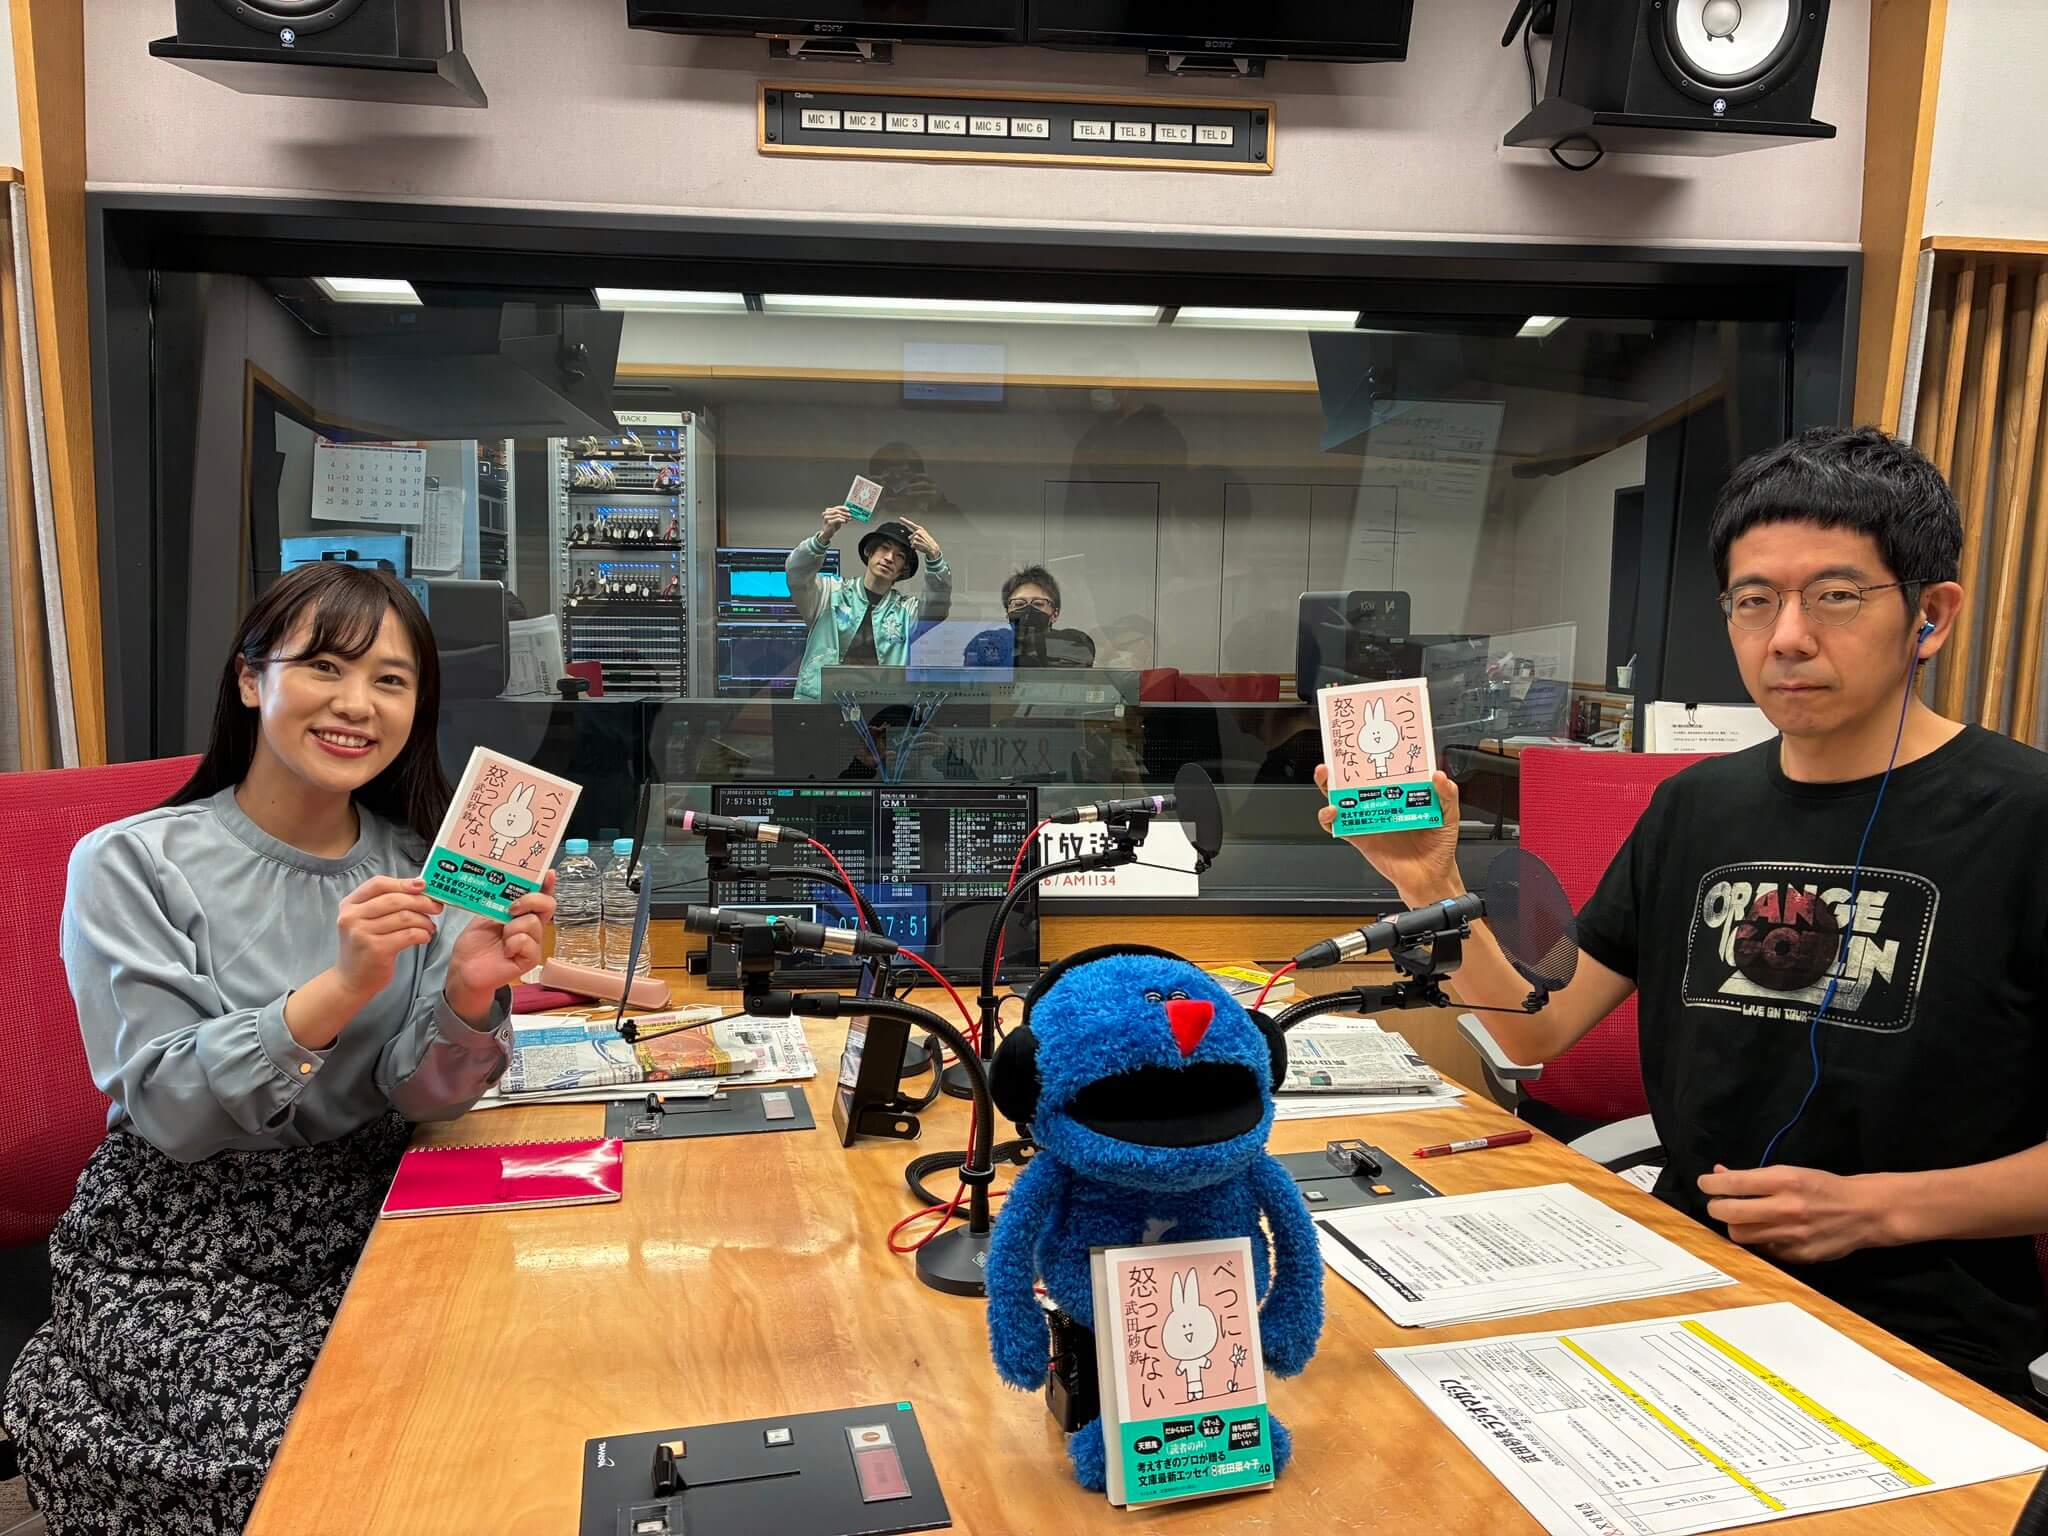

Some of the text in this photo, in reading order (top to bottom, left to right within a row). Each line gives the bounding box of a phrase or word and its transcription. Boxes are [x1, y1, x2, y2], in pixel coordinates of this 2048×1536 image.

[814, 24, 843, 33] SONY
[1205, 40, 1234, 49] SONY
[807, 113, 834, 125] MIC 1
[849, 115, 876, 127] MIC 2
[891, 116, 918, 128] MIC 3
[933, 119, 960, 130] MIC 4
[975, 120, 1001, 132] MIC 5
[1016, 121, 1043, 133] MIC 6
[1079, 125, 1105, 135] TEL A
[1119, 126, 1146, 137] TEL B
[1161, 128, 1187, 138] TEL C
[1202, 129, 1227, 140] TEL D
[620, 415, 643, 423] RACK
[403, 453, 408, 461] 2
[325, 497, 333, 505] 25
[384, 500, 392, 508] 29
[1395, 691, 1417, 742] べつに
[1331, 718, 1344, 758] 武田砂鉄
[1333, 696, 1360, 783] 怒ってない
[458, 764, 509, 849] 怒ってない
[461, 783, 486, 824] 武田砂鉄
[725, 797, 756, 806] 7:57:51
[532, 791, 564, 839] べつに
[1702, 880, 1890, 960] ORANGE
[1742, 1003, 1766, 1018] LIVE
[1212, 1259, 1243, 1340] べつに
[1123, 1299, 1143, 1366] 武田砂鉄
[1127, 1265, 1166, 1409] 怒ってない
[1439, 1378, 1545, 1465] 武田砂鉄ラジオマガジン
[1136, 1451, 1227, 1474] 考えすぎのプロが贈る
[1137, 1467, 1210, 1488] 文庫最新エッセイ
